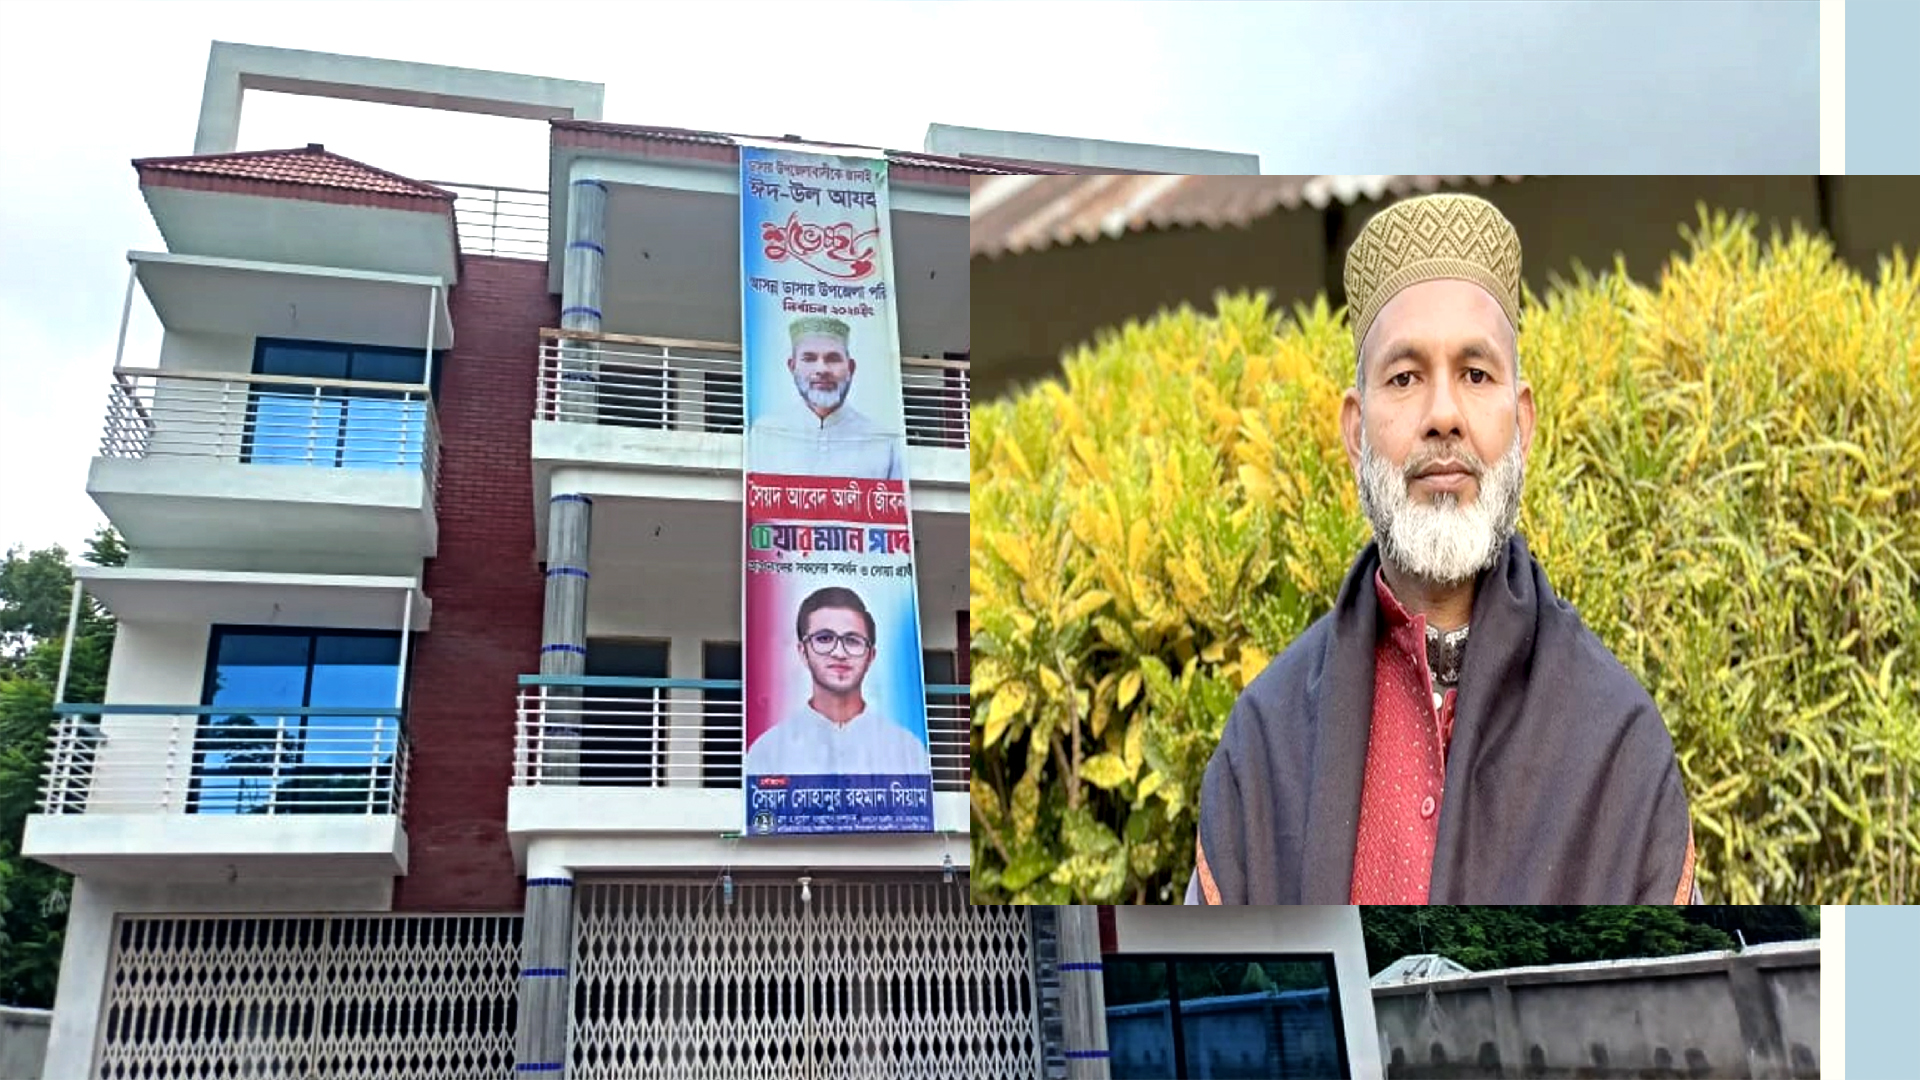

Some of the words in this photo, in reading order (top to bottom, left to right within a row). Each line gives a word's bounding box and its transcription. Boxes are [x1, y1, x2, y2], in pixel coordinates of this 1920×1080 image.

[749, 178, 821, 207] ঈদ-উল
[761, 211, 880, 279] শুভেচ্ছা
[818, 281, 864, 299] উপজেলা
[783, 297, 827, 314] নির্বাচন
[749, 480, 783, 509] সৈয়দ
[786, 486, 828, 511] আবেদ
[832, 480, 863, 513] আলী
[751, 784, 788, 810] সৈয়দ
[791, 787, 841, 812] সোহানুর
[846, 787, 887, 809] রহমান
[890, 782, 928, 809] সিয়াম
